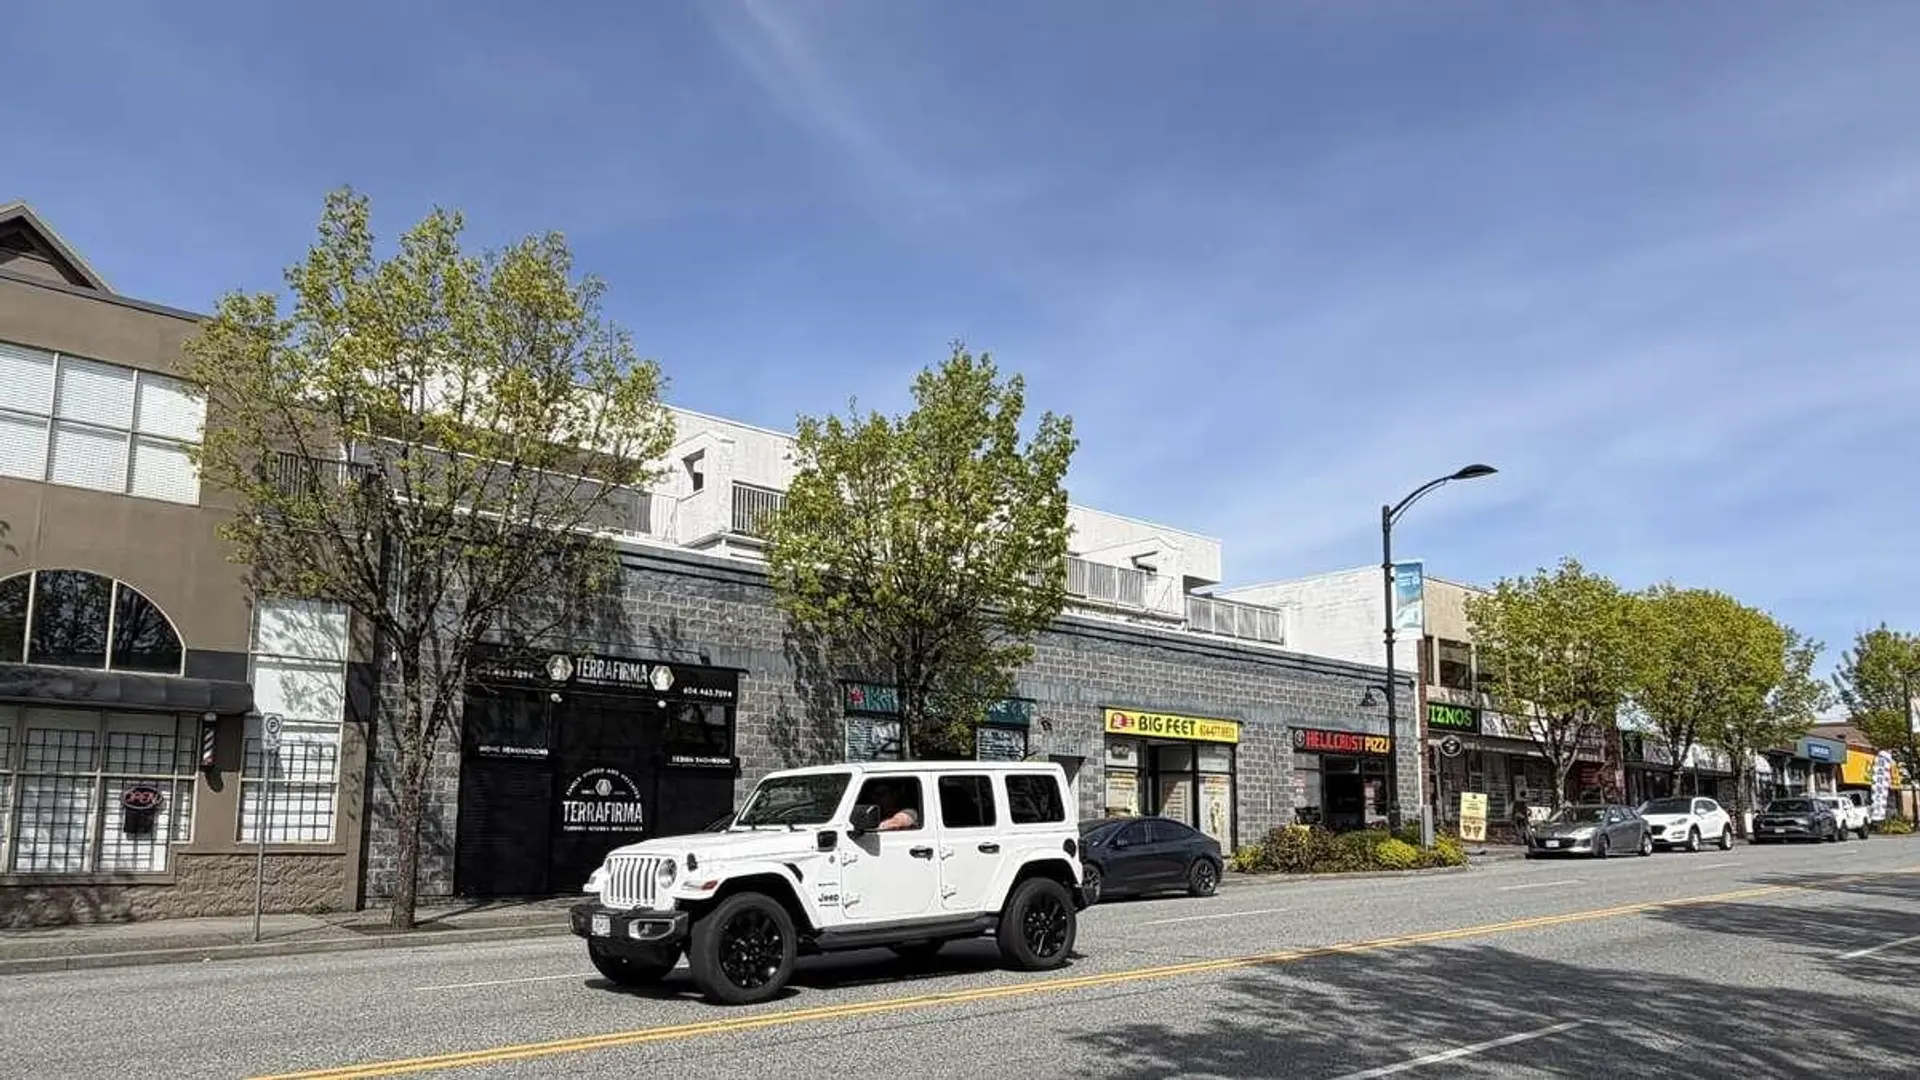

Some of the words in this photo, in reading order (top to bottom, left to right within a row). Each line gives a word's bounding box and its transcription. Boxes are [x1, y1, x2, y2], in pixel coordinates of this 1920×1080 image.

[576, 658, 648, 683] TERRAFIRMA
[1139, 715, 1163, 733] BIG
[1165, 717, 1197, 736] FEET
[1428, 704, 1473, 727] IZNOS
[1305, 729, 1364, 751] HELLCRUST
[124, 790, 158, 804] OPEN
[563, 801, 643, 823] TERRAFIRMA
[817, 893, 840, 902] Jeep
